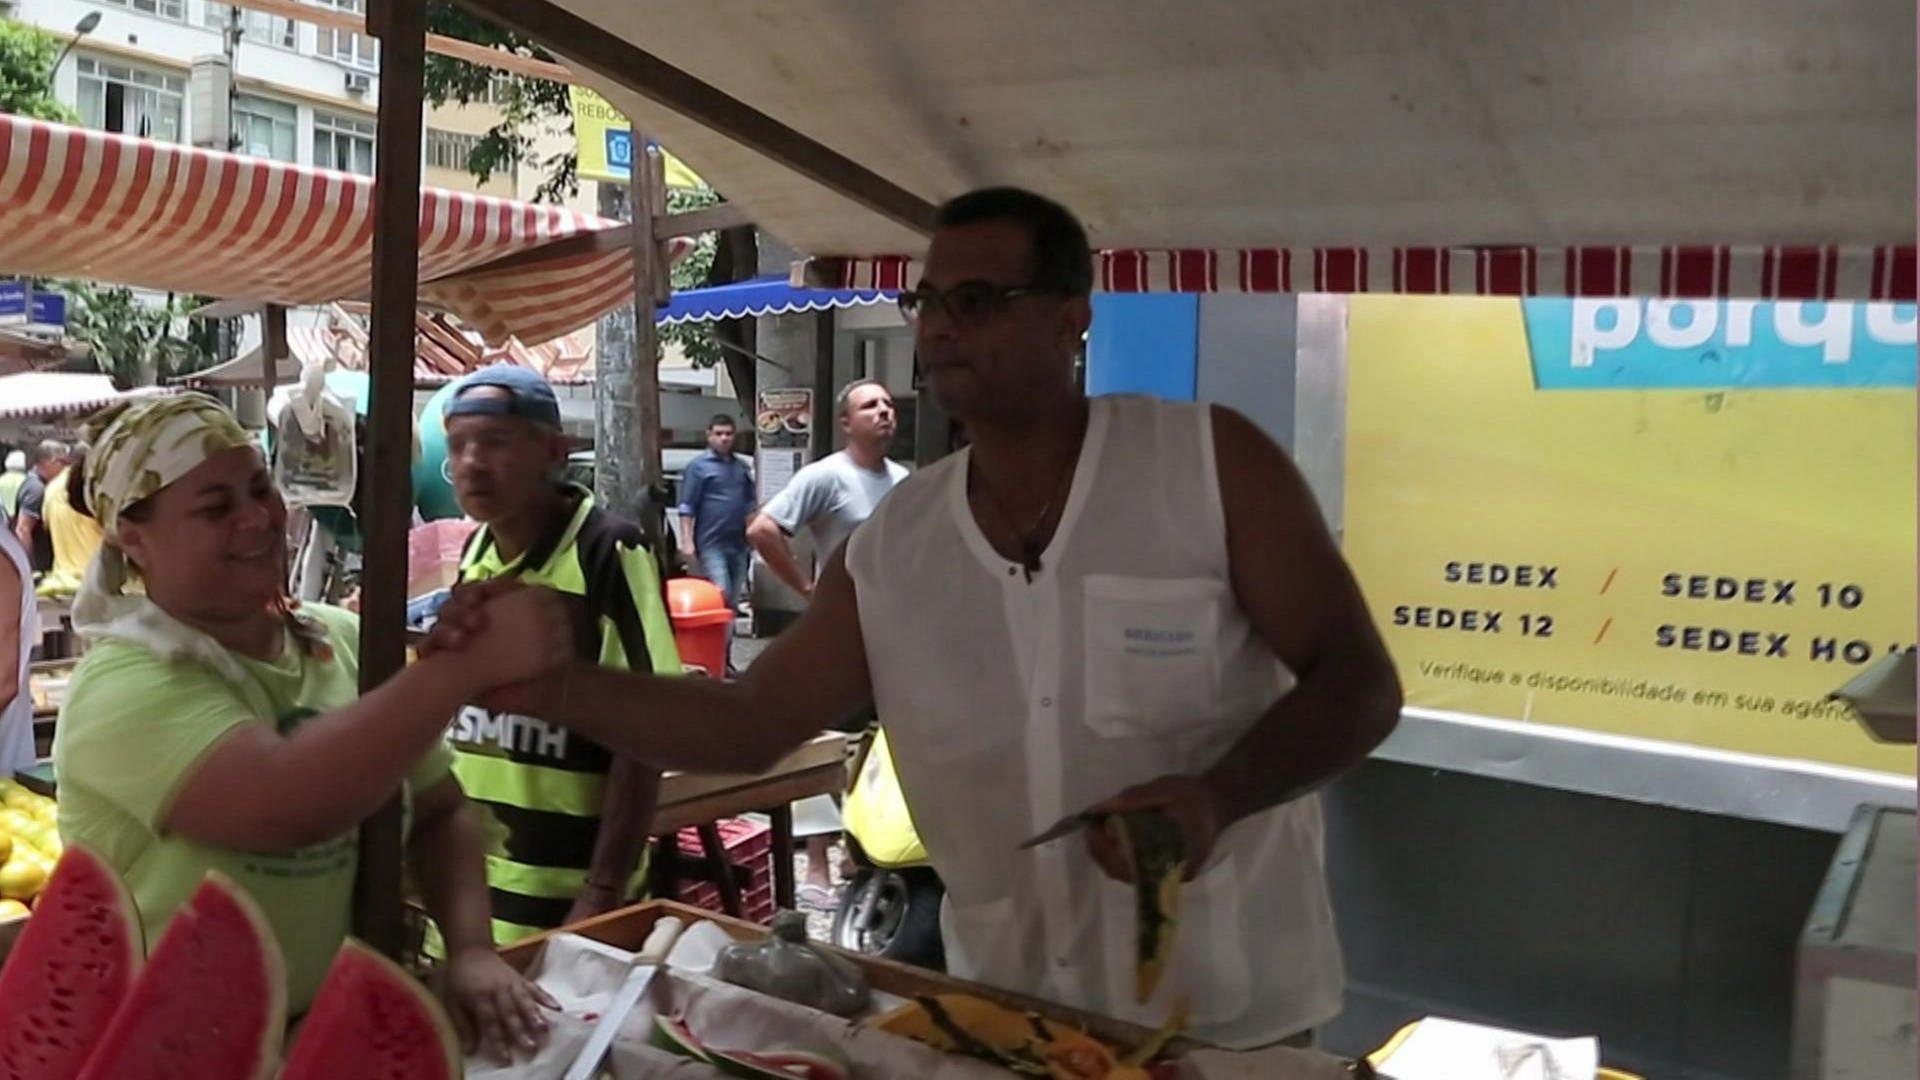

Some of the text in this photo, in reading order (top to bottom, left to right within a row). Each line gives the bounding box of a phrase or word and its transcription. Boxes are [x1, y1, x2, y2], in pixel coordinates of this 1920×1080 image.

[1444, 561, 1559, 588] SEDEX
[1661, 572, 1798, 606] SEDEX
[1816, 583, 1864, 610] 10
[1393, 605, 1503, 634] SEDEX
[1518, 614, 1555, 638] 12
[1655, 624, 1791, 658] SEDEX
[1419, 659, 1857, 722] Verifique a disponibilidade em sua agênc
[449, 704, 568, 760] SMITH
